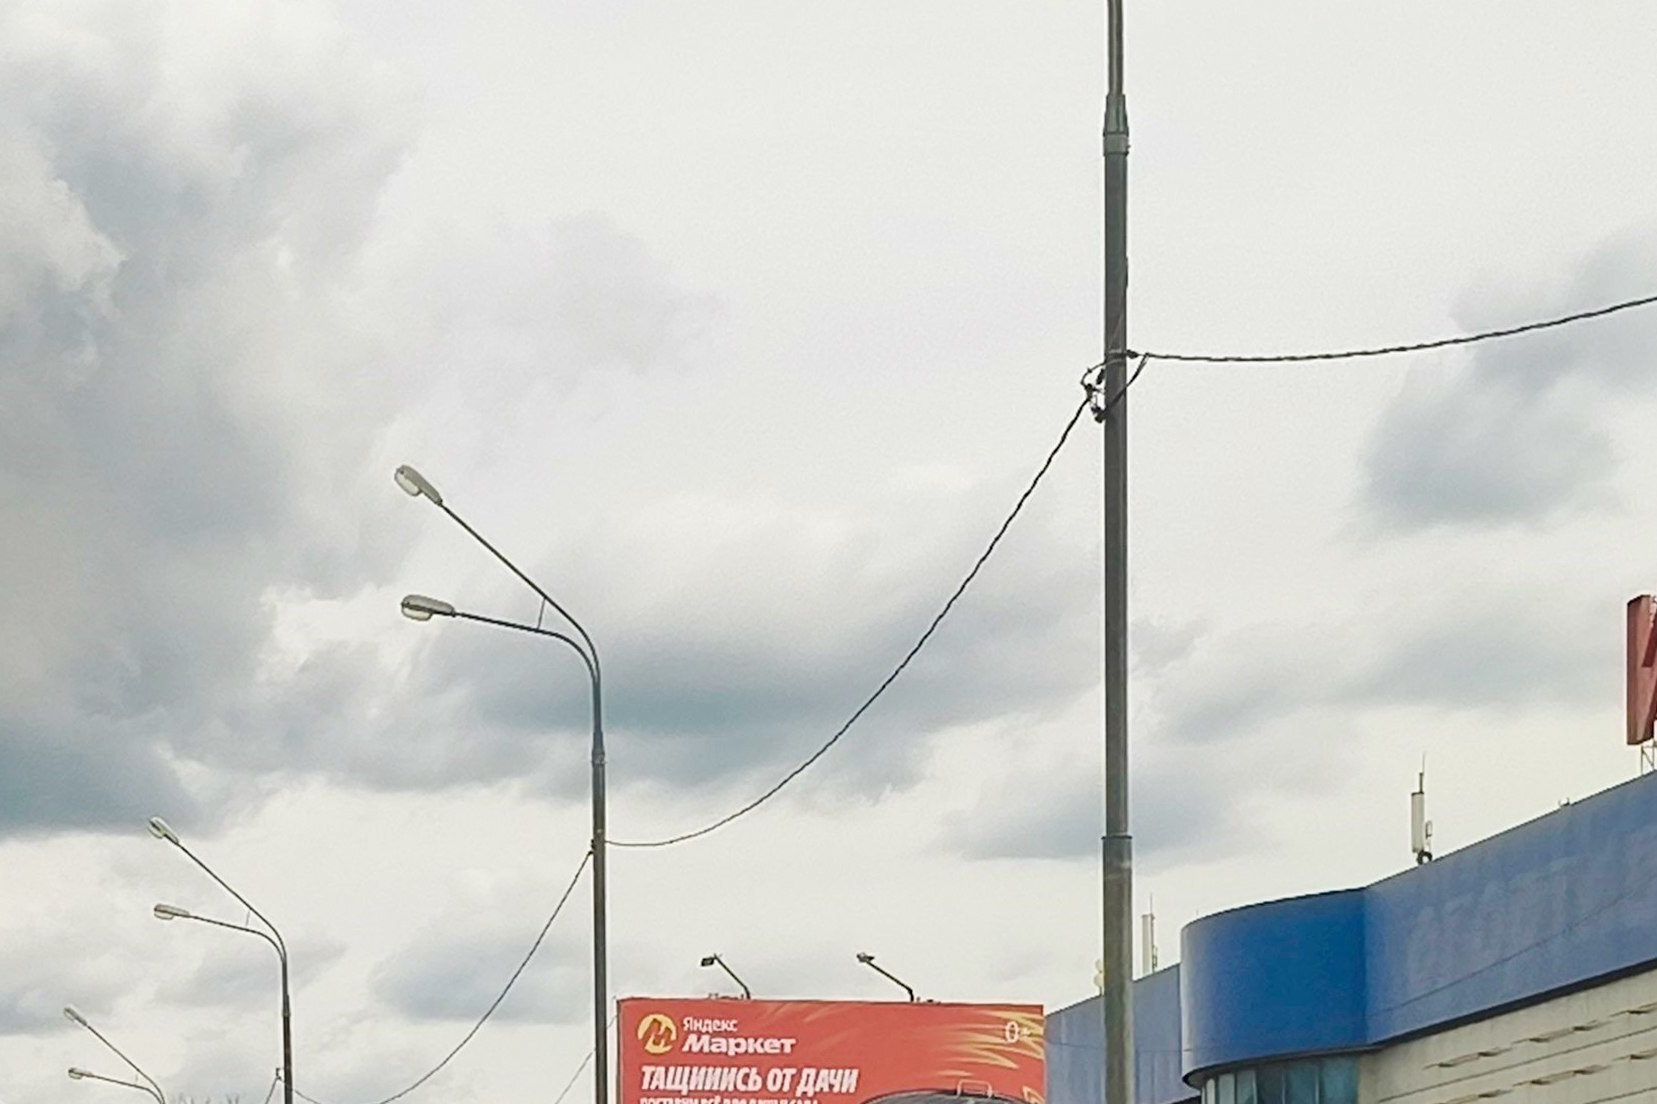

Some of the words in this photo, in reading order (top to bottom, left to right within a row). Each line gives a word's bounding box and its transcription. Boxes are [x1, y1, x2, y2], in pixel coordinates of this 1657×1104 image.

[683, 1017, 738, 1033] Яндекс
[682, 1034, 796, 1056] Маркет
[641, 1066, 763, 1096] ТАЩИИИСЬ
[766, 1067, 797, 1092] ОТ
[795, 1069, 859, 1098] ДАЧИ
